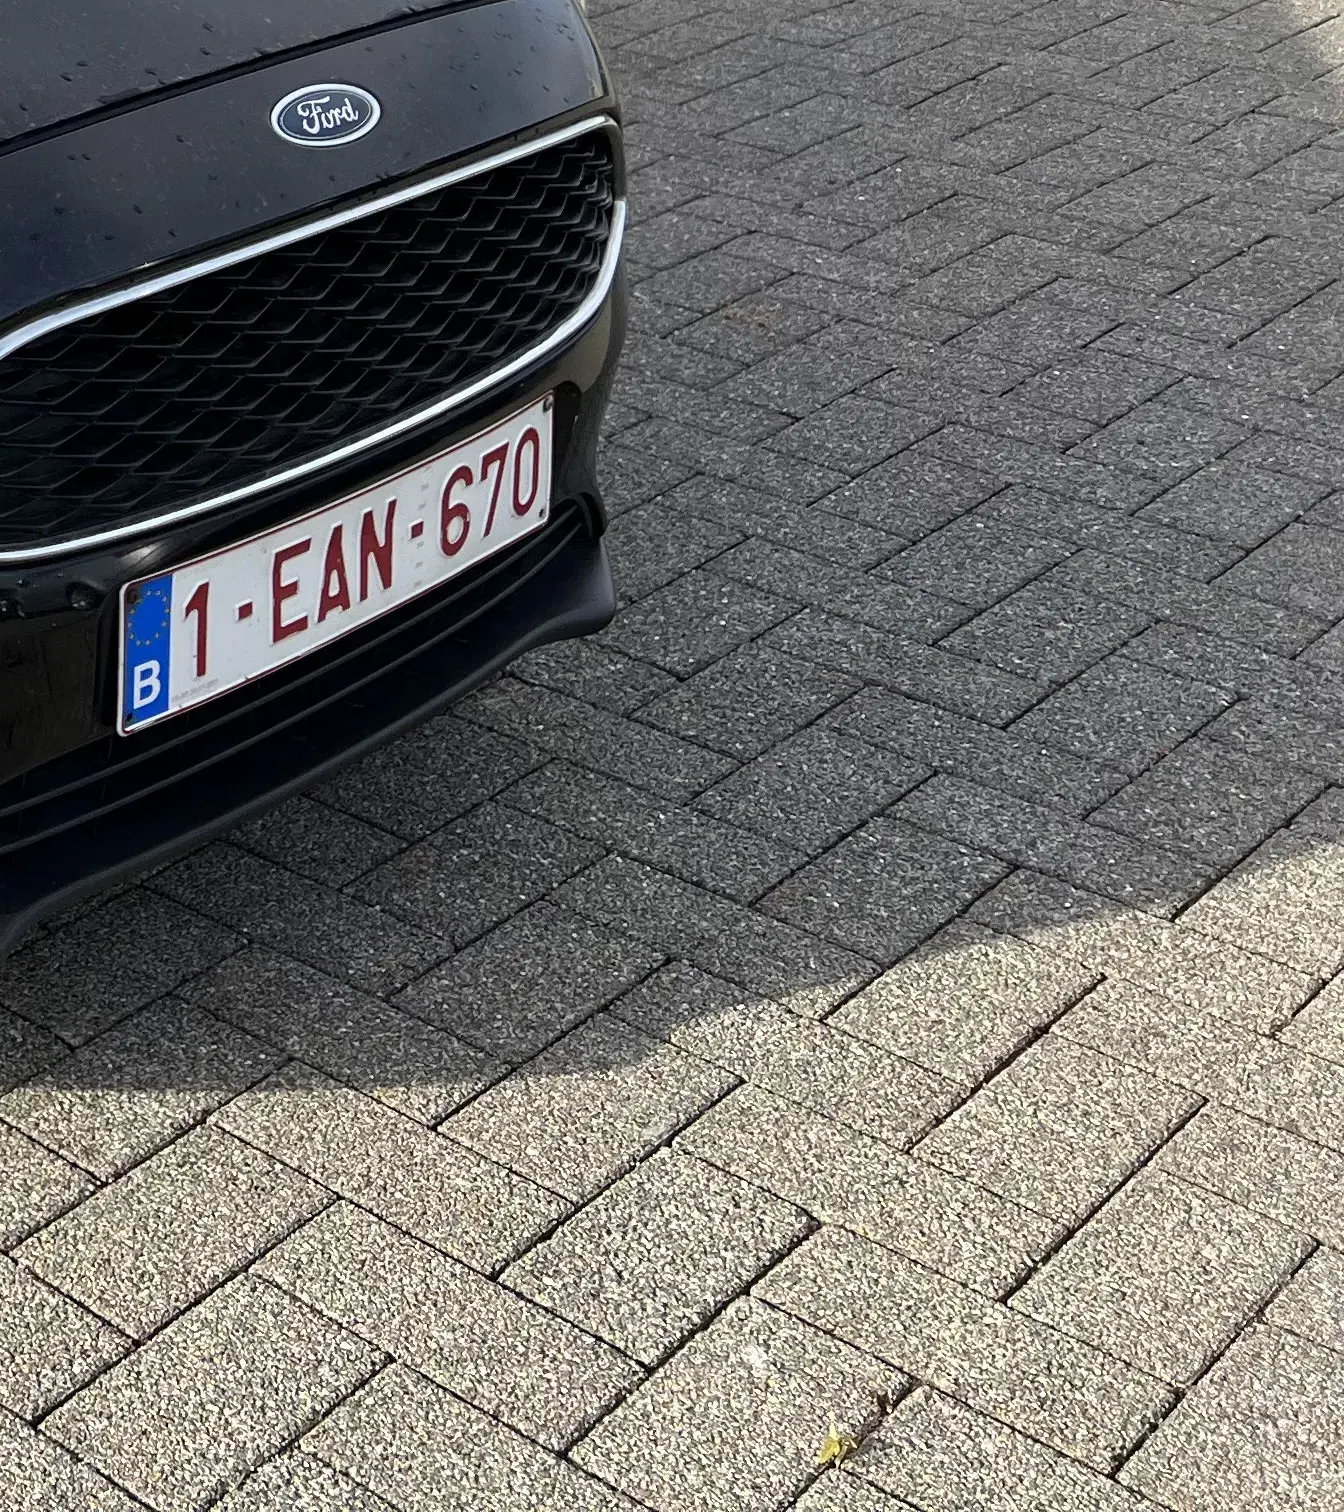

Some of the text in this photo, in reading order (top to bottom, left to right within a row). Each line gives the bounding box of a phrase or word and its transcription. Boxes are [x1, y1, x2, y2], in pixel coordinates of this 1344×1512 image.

[296, 95, 359, 134] Ford
[132, 426, 540, 710] B 1-EAN-670
